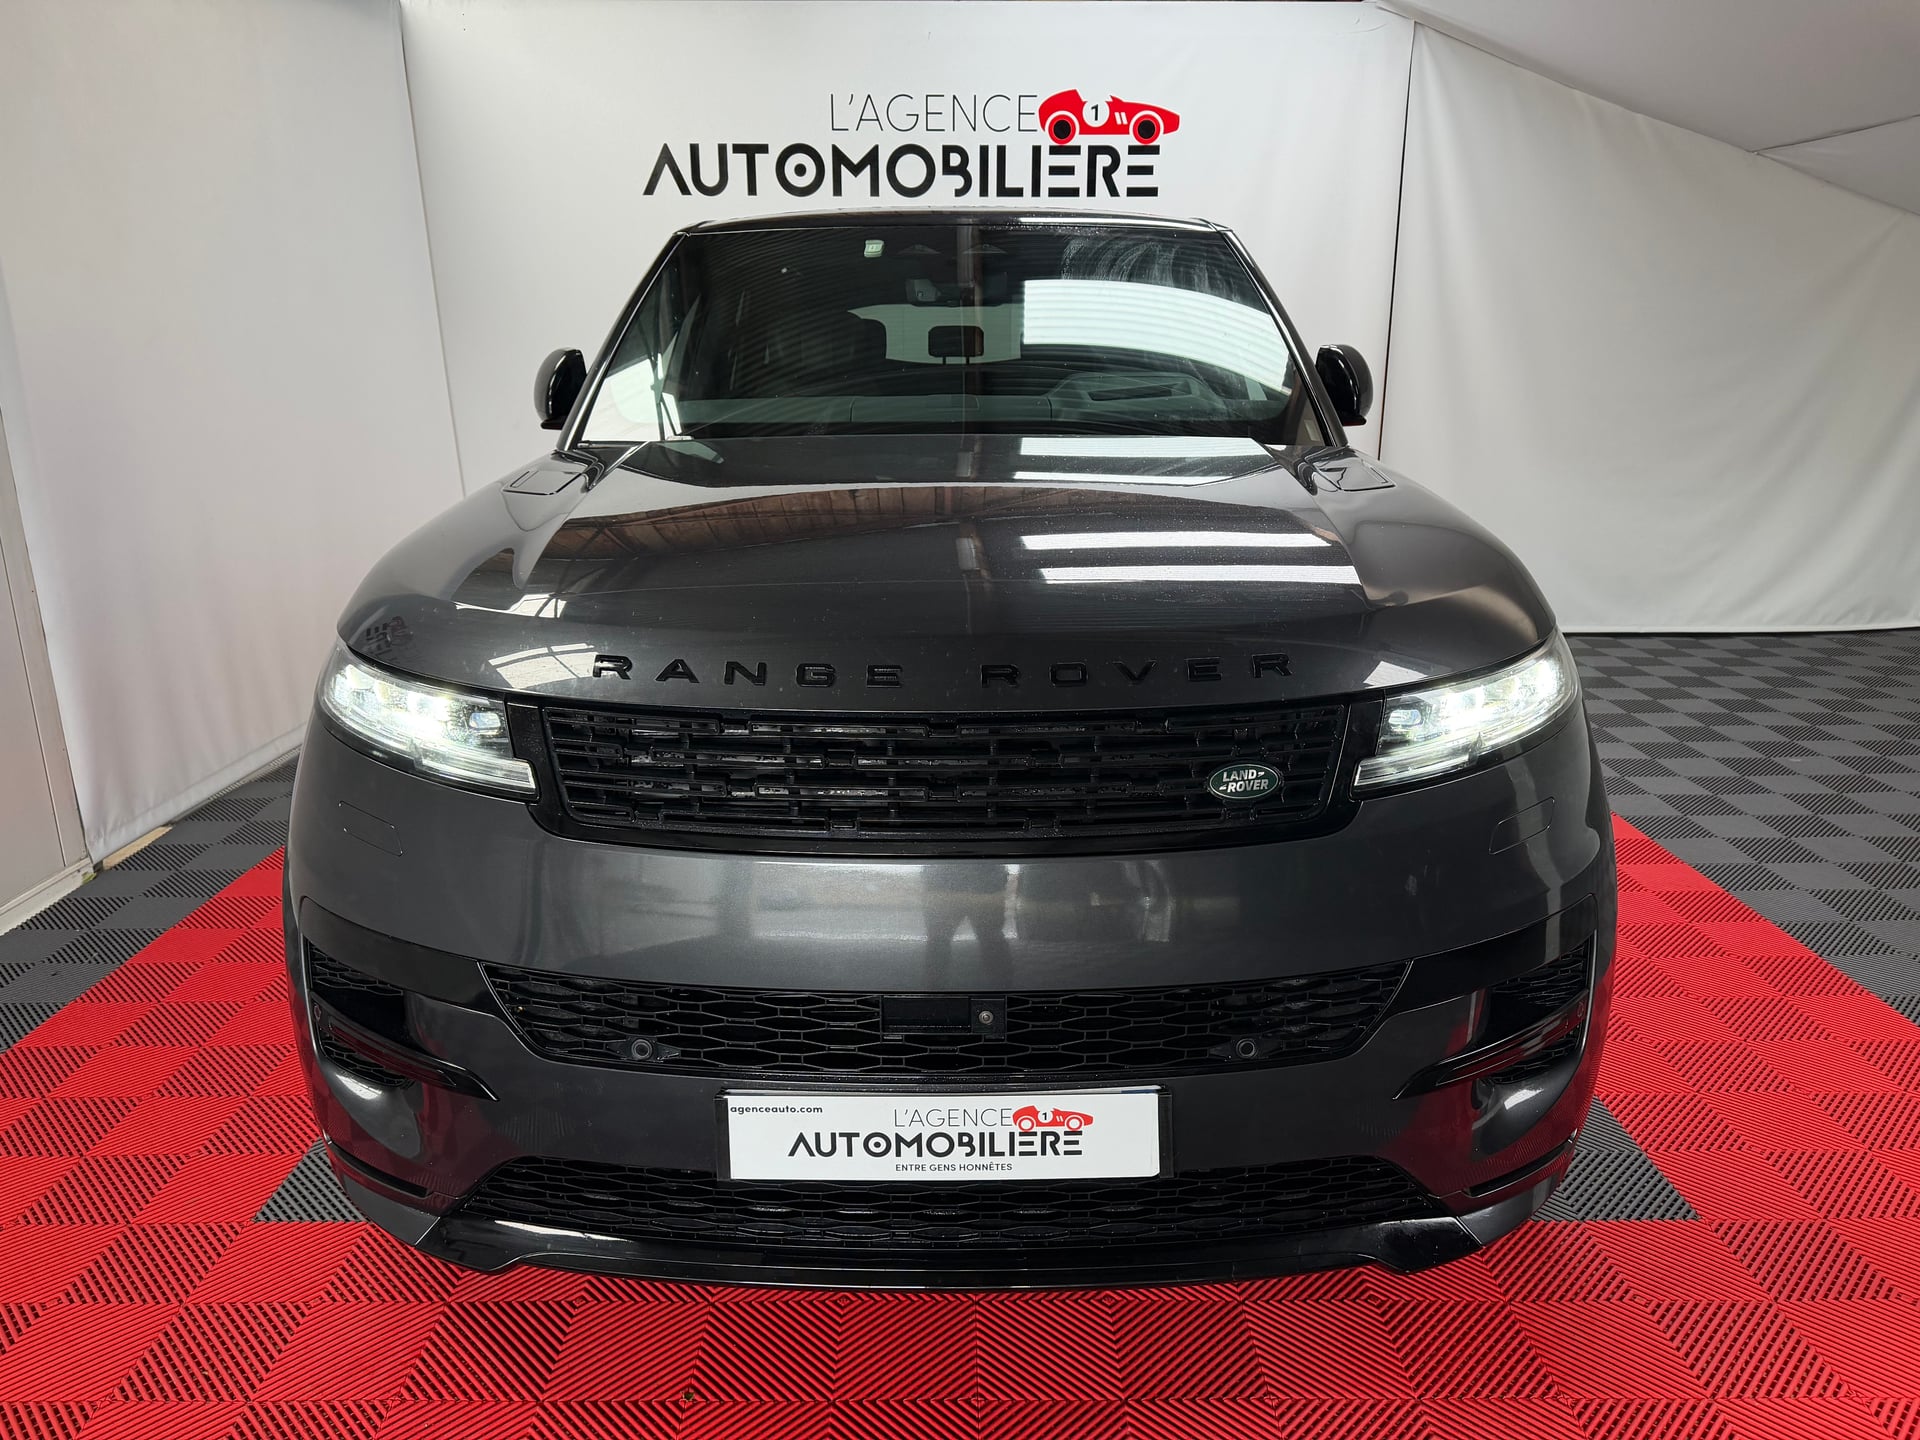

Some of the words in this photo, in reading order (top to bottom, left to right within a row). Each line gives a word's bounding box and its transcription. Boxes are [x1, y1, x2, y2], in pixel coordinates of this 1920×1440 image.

[829, 94, 1037, 132] L'AGENCE
[592, 654, 902, 688] RANGE
[979, 652, 1293, 688] ROVER
[1227, 779, 1268, 793] ROVER
[730, 1105, 823, 1115] agenceauto.com
[894, 1108, 1013, 1127] L'AGENCE
[895, 1163, 927, 1171] ENTRE
[929, 1163, 957, 1171] GENS
[959, 1160, 1013, 1171] HONNÊTES
